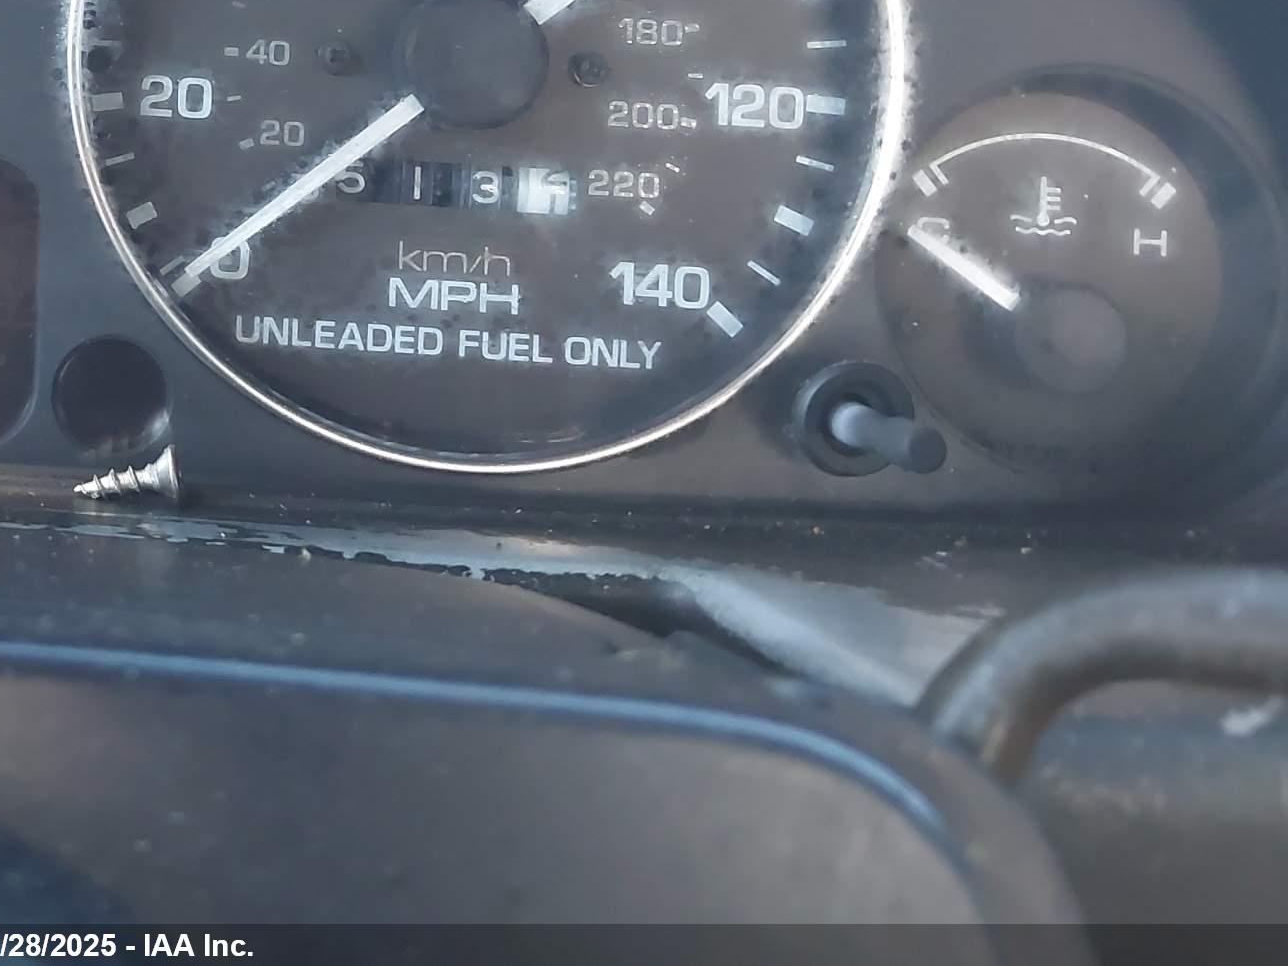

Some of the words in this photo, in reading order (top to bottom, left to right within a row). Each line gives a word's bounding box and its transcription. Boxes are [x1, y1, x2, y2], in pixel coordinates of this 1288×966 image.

[618, 17, 683, 46] 180
[246, 39, 290, 65] 40
[140, 74, 212, 119] 20
[705, 82, 804, 129] 120
[608, 100, 679, 130] 200
[260, 120, 304, 147] 20
[588, 170, 659, 198] 220
[398, 240, 511, 276] km/h
[1133, 228, 1167, 257] H
[388, 277, 519, 315] MPH
[610, 262, 710, 310] 140
[236, 315, 443, 355] UNLEADED
[459, 329, 553, 365] FUEL
[564, 336, 662, 370] ONLY
